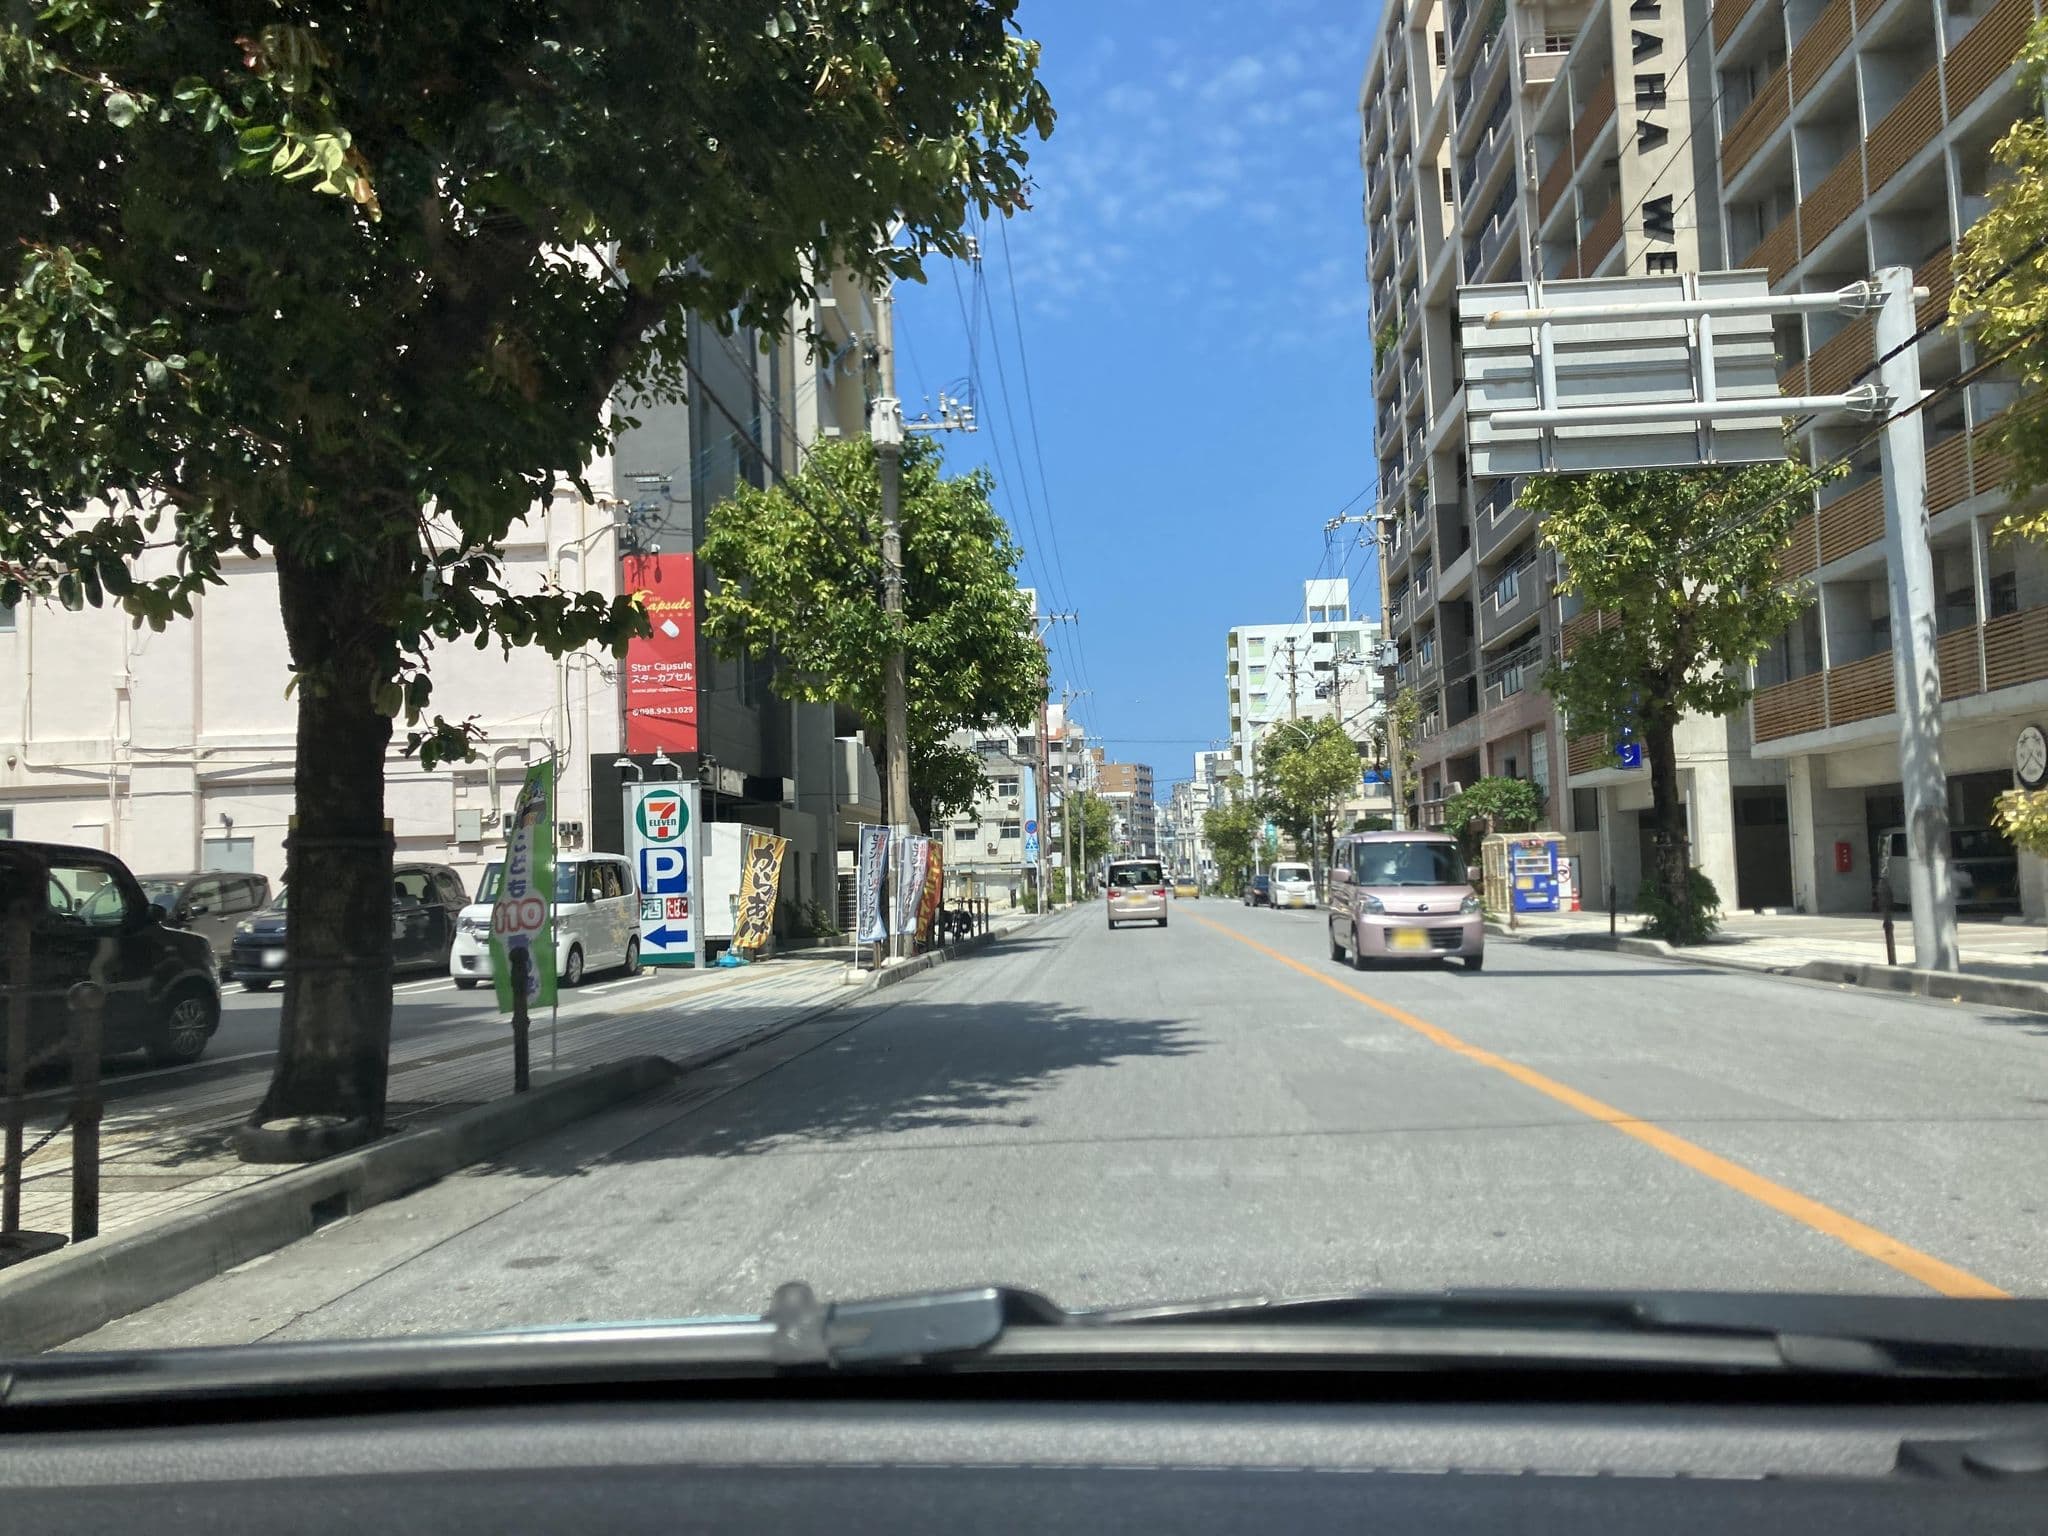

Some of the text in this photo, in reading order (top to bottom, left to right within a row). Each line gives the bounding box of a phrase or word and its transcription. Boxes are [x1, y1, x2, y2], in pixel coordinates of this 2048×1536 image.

[631, 661, 693, 673] Star Capsule
[646, 850, 684, 893] P
[739, 842, 777, 941] からあげ
[642, 898, 688, 919] 酒 たばこ
